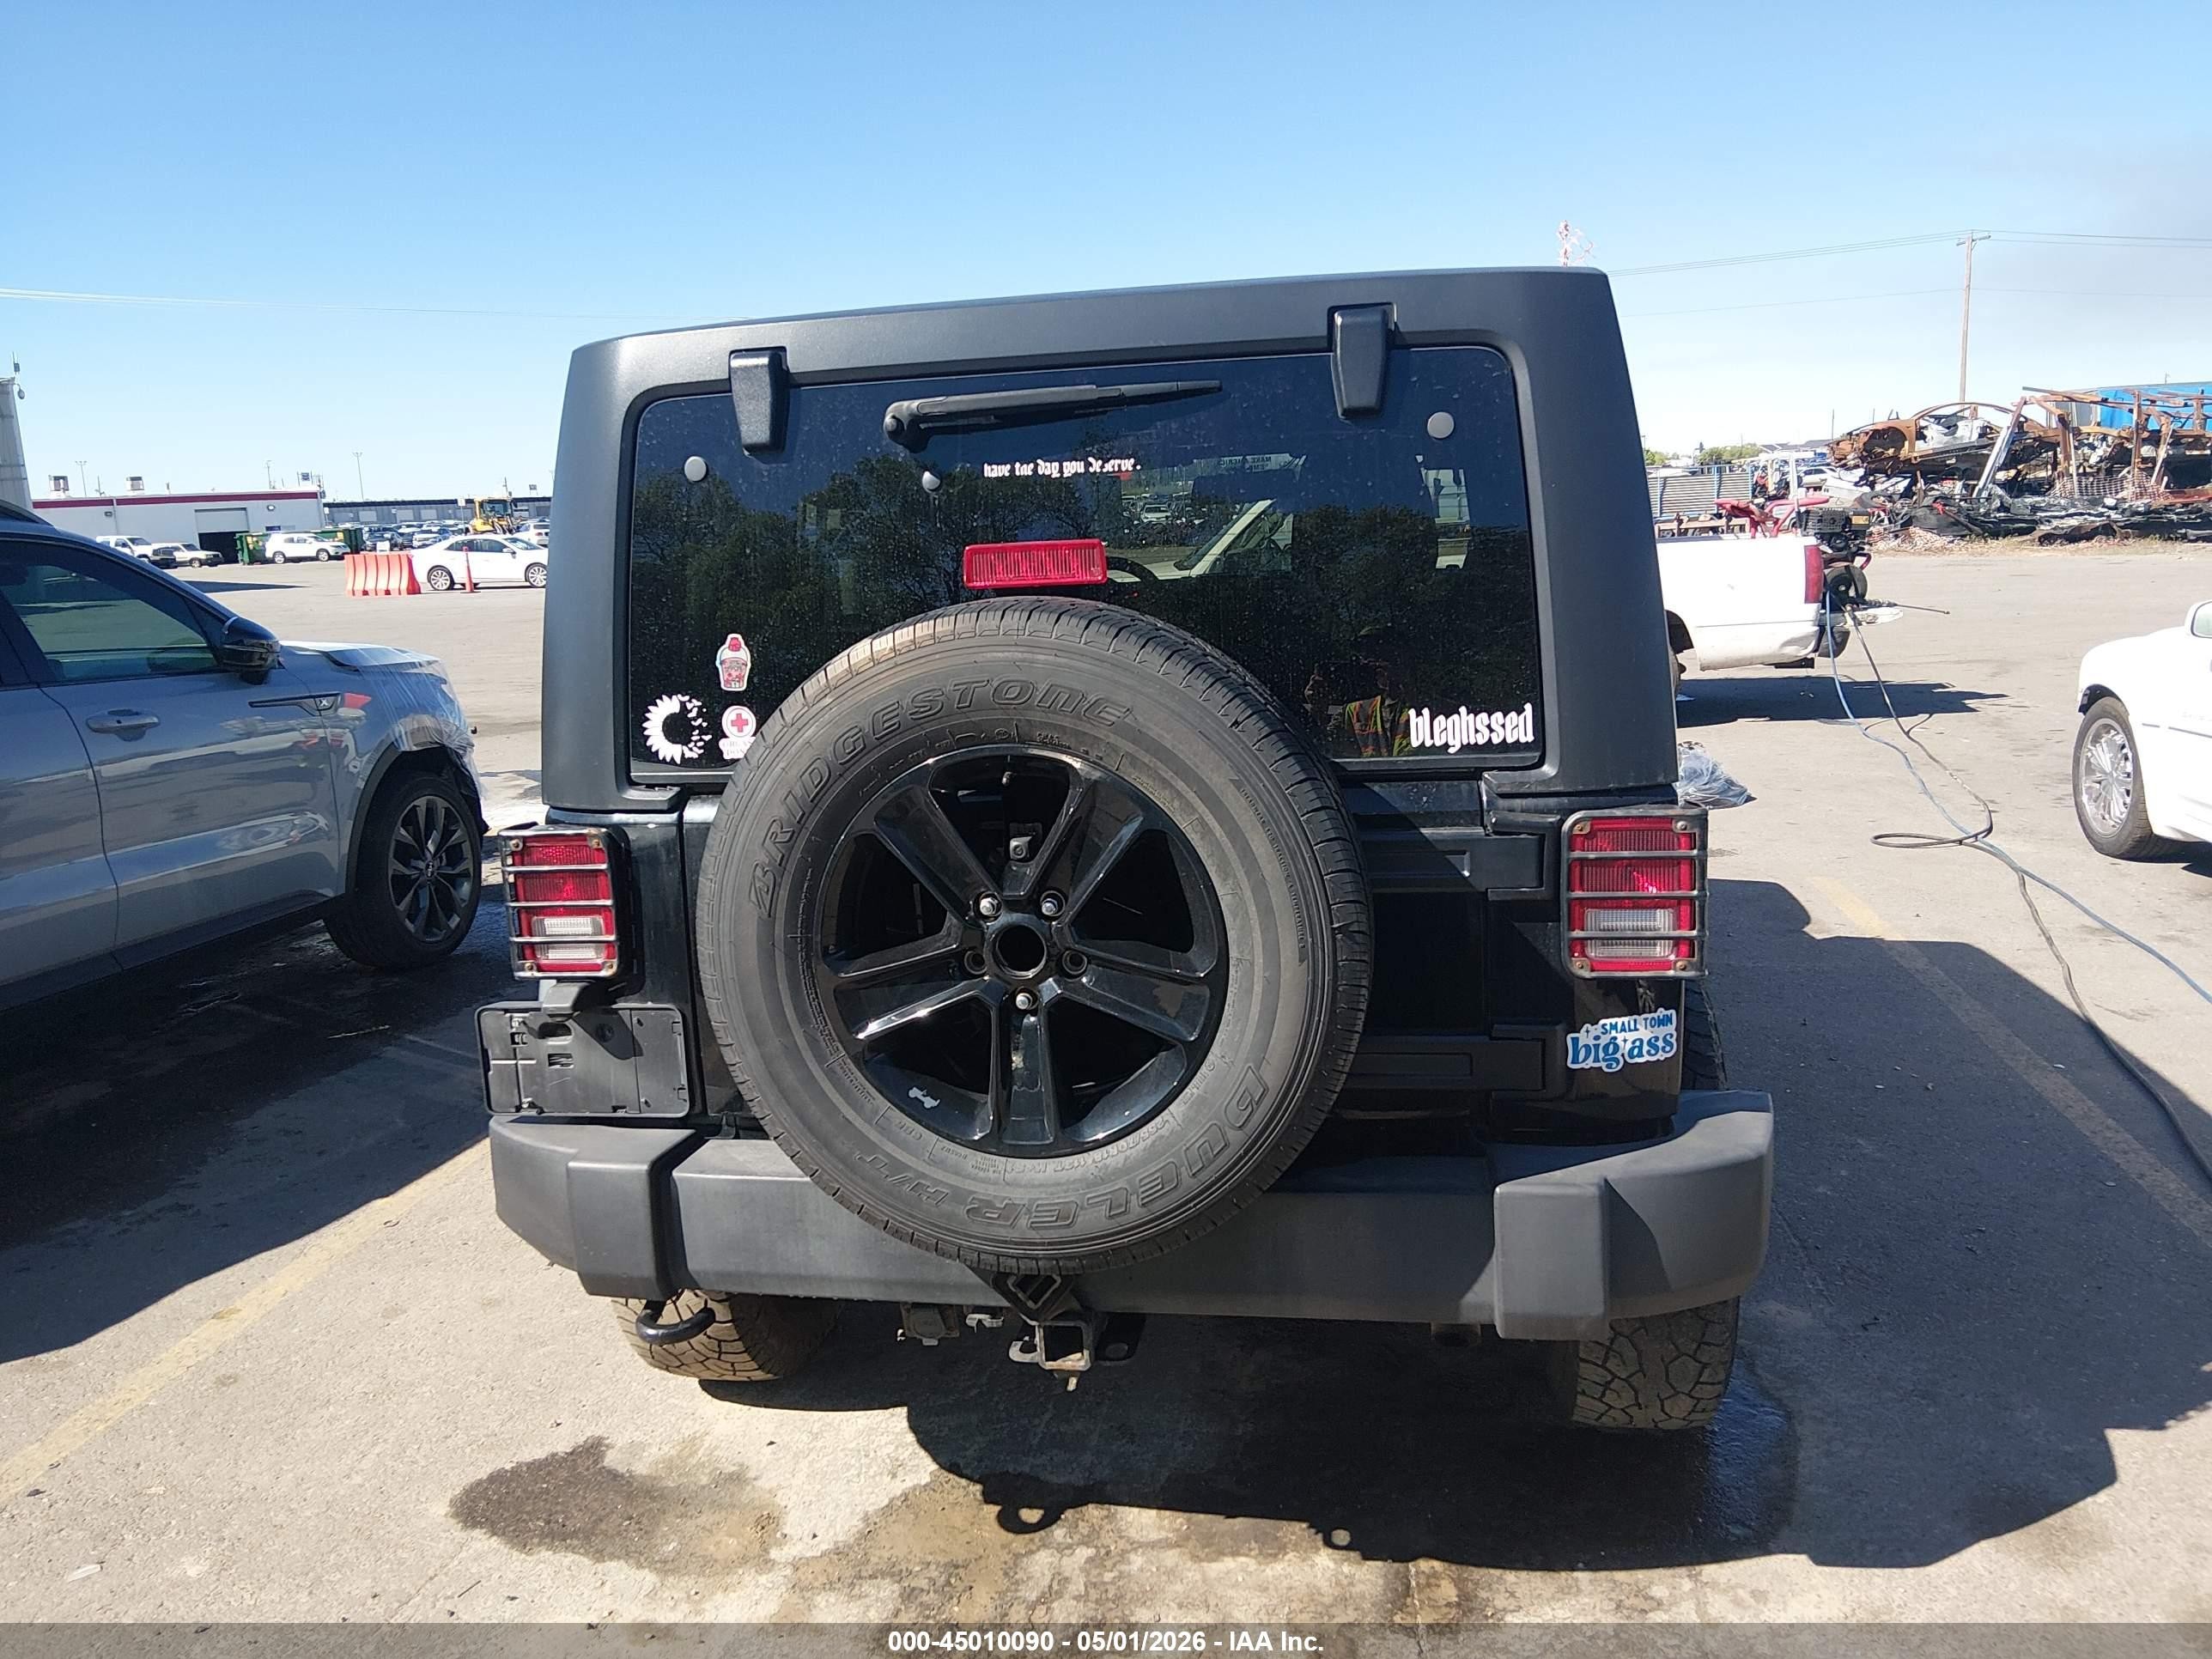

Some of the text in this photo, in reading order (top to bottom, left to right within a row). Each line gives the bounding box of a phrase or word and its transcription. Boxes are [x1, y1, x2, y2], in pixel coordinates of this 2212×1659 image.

[984, 462, 1011, 477] have
[1036, 459, 1061, 478] day
[1063, 460, 1085, 478] you
[1407, 702, 1535, 755] bleghssed
[748, 678, 1133, 918] BRIDGESTONE
[1601, 1012, 1674, 1036] SMALL TOWN
[1571, 1032, 1674, 1070] big ass
[965, 1064, 1269, 1230] DUELER
